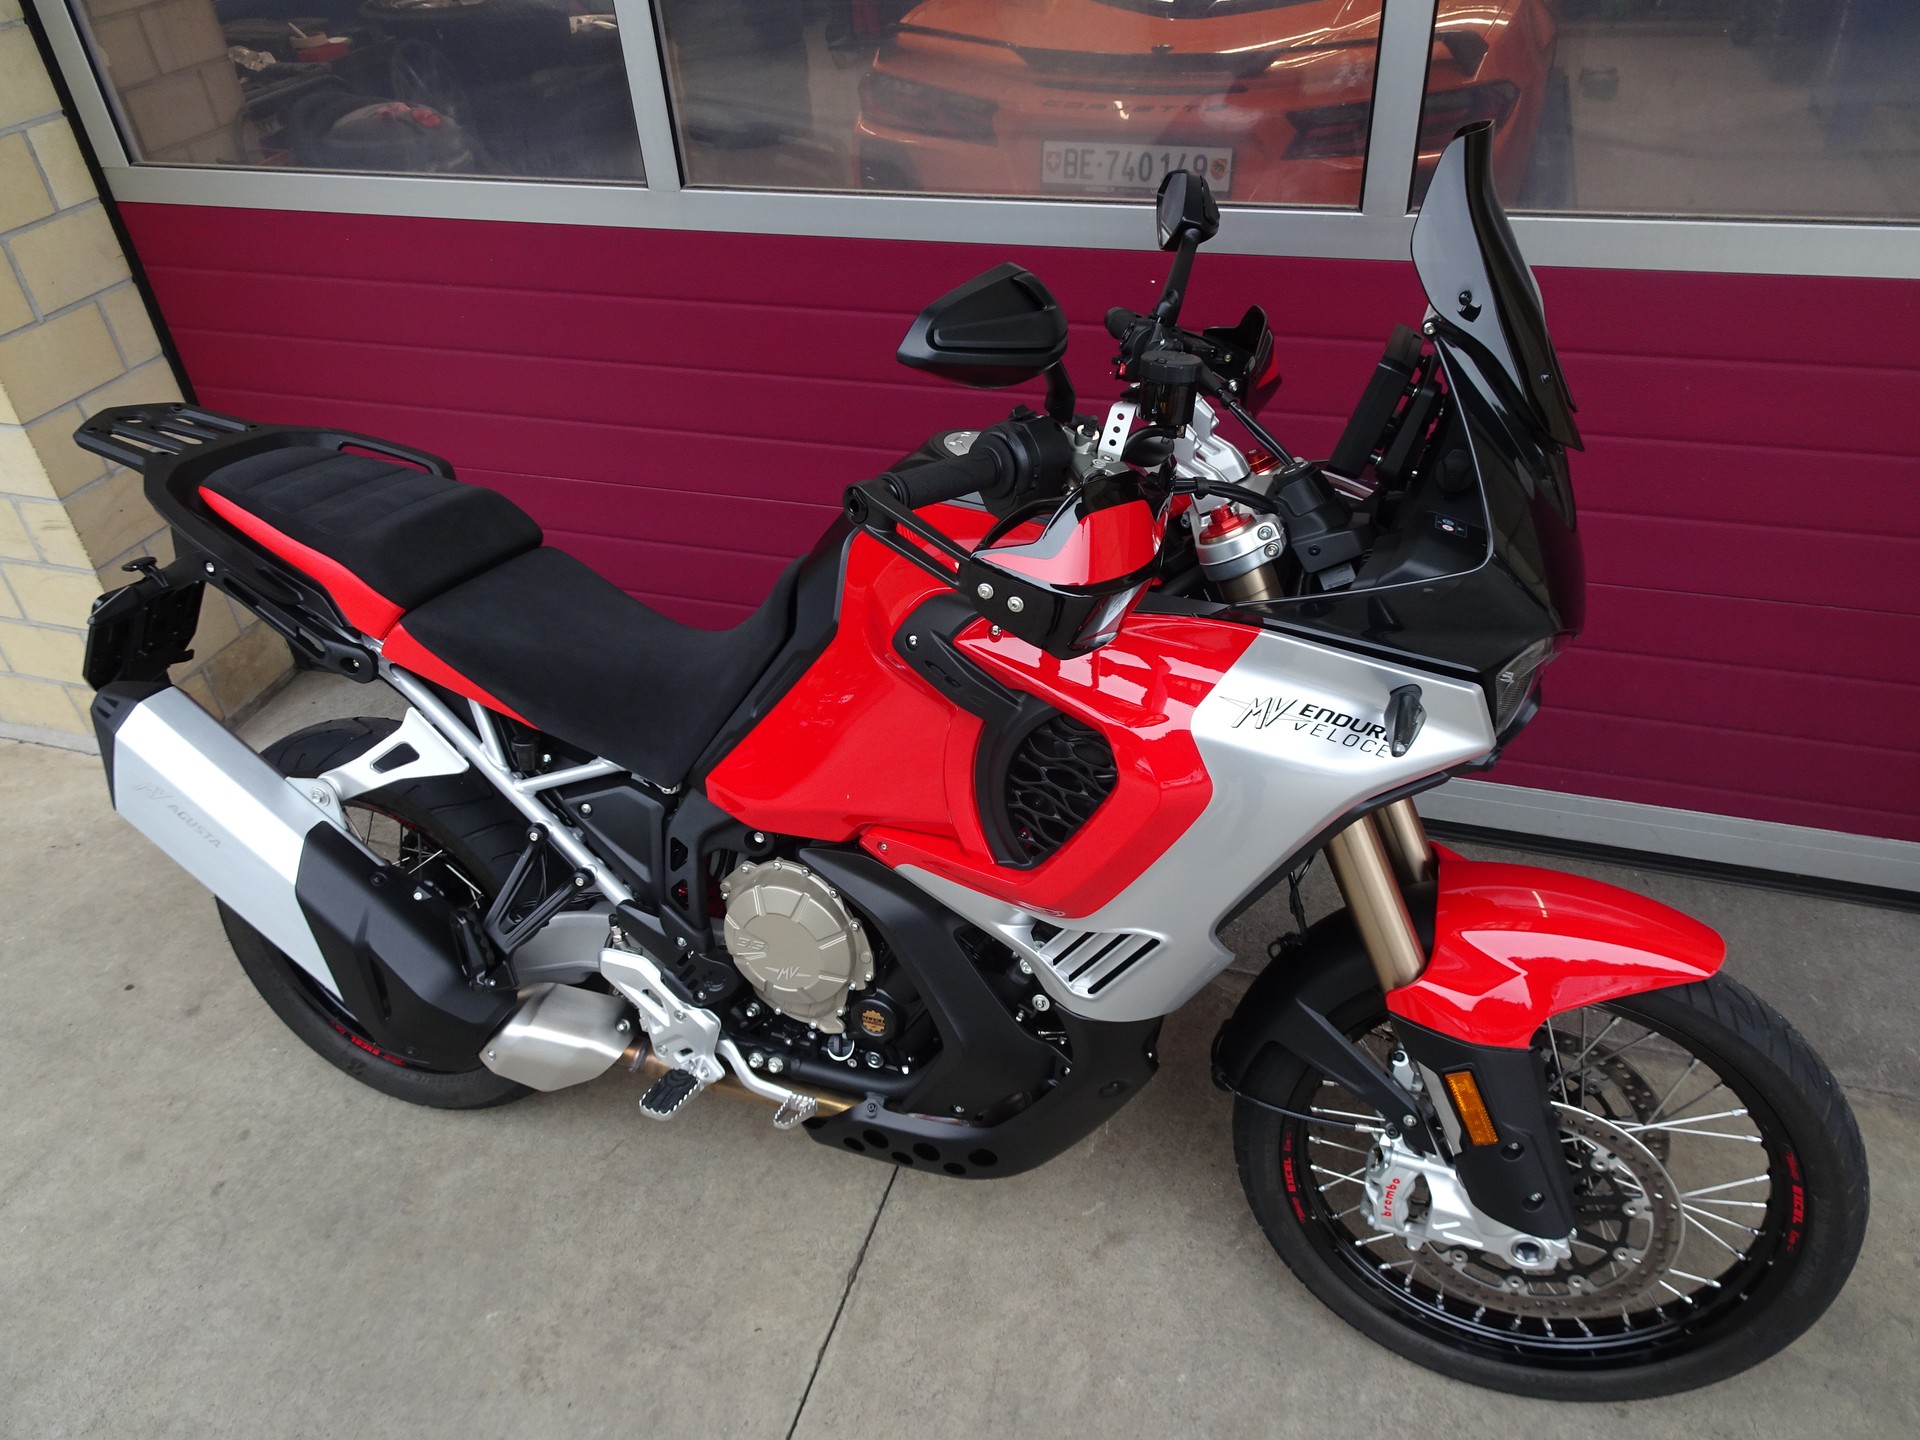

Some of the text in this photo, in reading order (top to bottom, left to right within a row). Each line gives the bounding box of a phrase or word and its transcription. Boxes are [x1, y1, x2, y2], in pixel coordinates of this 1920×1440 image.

[1229, 696, 1390, 742] MV ENDUR
[1294, 722, 1390, 759] VELOCE
[168, 804, 221, 848] AGUSTA
[1381, 1178, 1401, 1217] brembo
